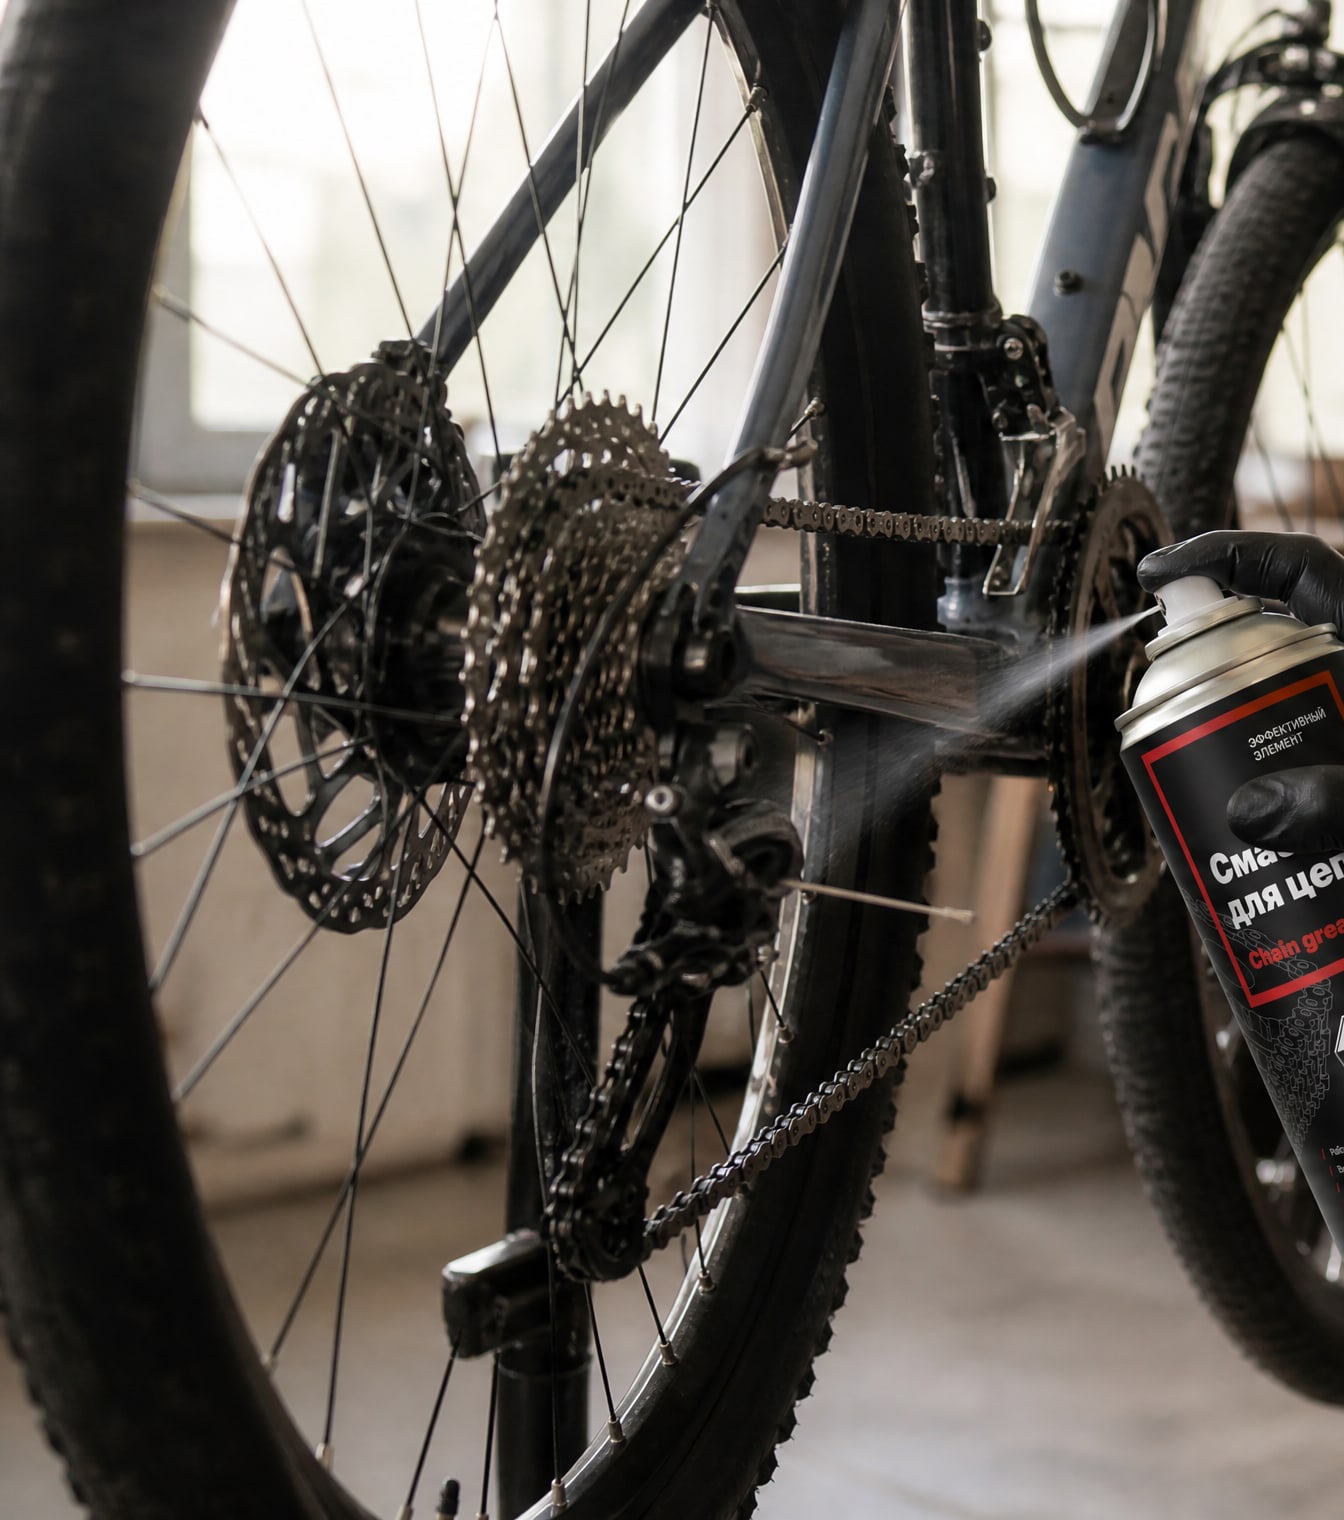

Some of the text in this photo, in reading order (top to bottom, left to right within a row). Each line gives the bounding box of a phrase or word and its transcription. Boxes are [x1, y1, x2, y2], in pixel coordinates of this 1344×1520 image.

[1248, 706, 1327, 748] ЭФФЕКТИВНЫЙ
[1253, 732, 1304, 761] ЭЛЕМЕНТ
[1227, 882, 1285, 930] для
[1249, 939, 1301, 970] Chain
